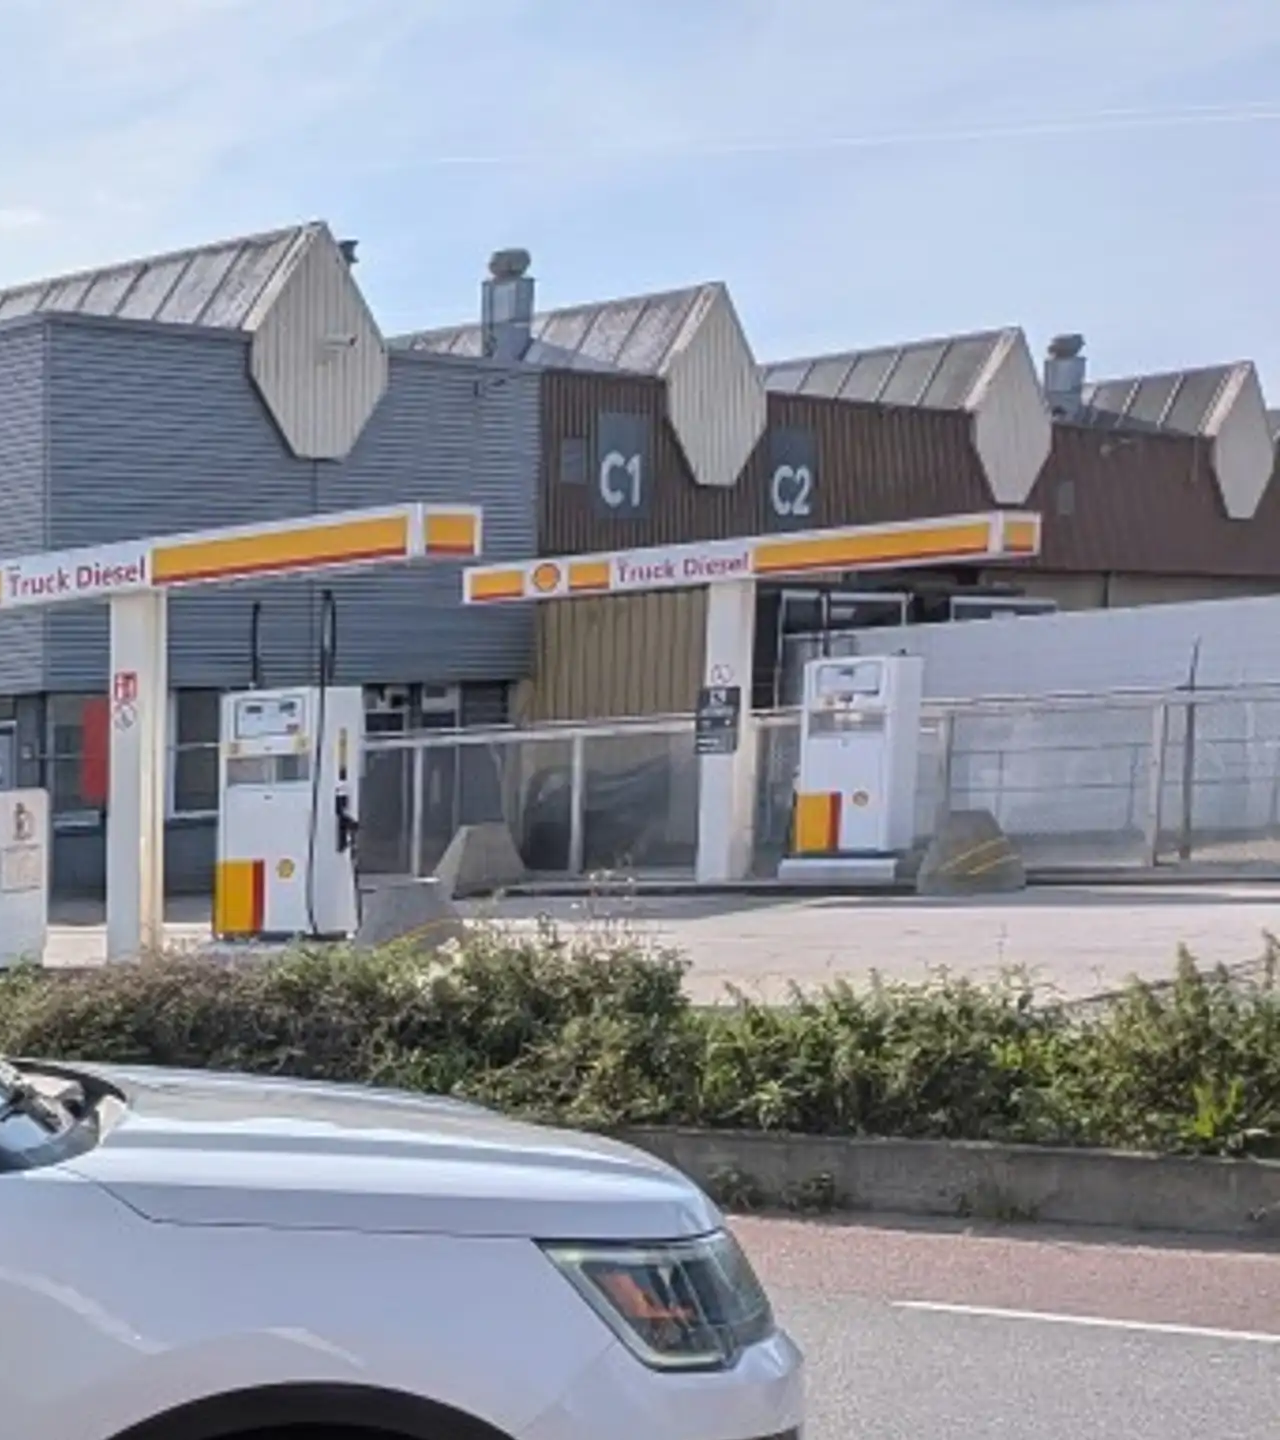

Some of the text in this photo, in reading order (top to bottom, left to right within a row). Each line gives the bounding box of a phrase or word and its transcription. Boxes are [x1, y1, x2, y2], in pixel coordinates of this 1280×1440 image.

[600, 450, 641, 507] C1
[772, 464, 812, 515] C2
[8, 555, 146, 596] Truck Diesel
[618, 552, 749, 582] Truck Diesel
